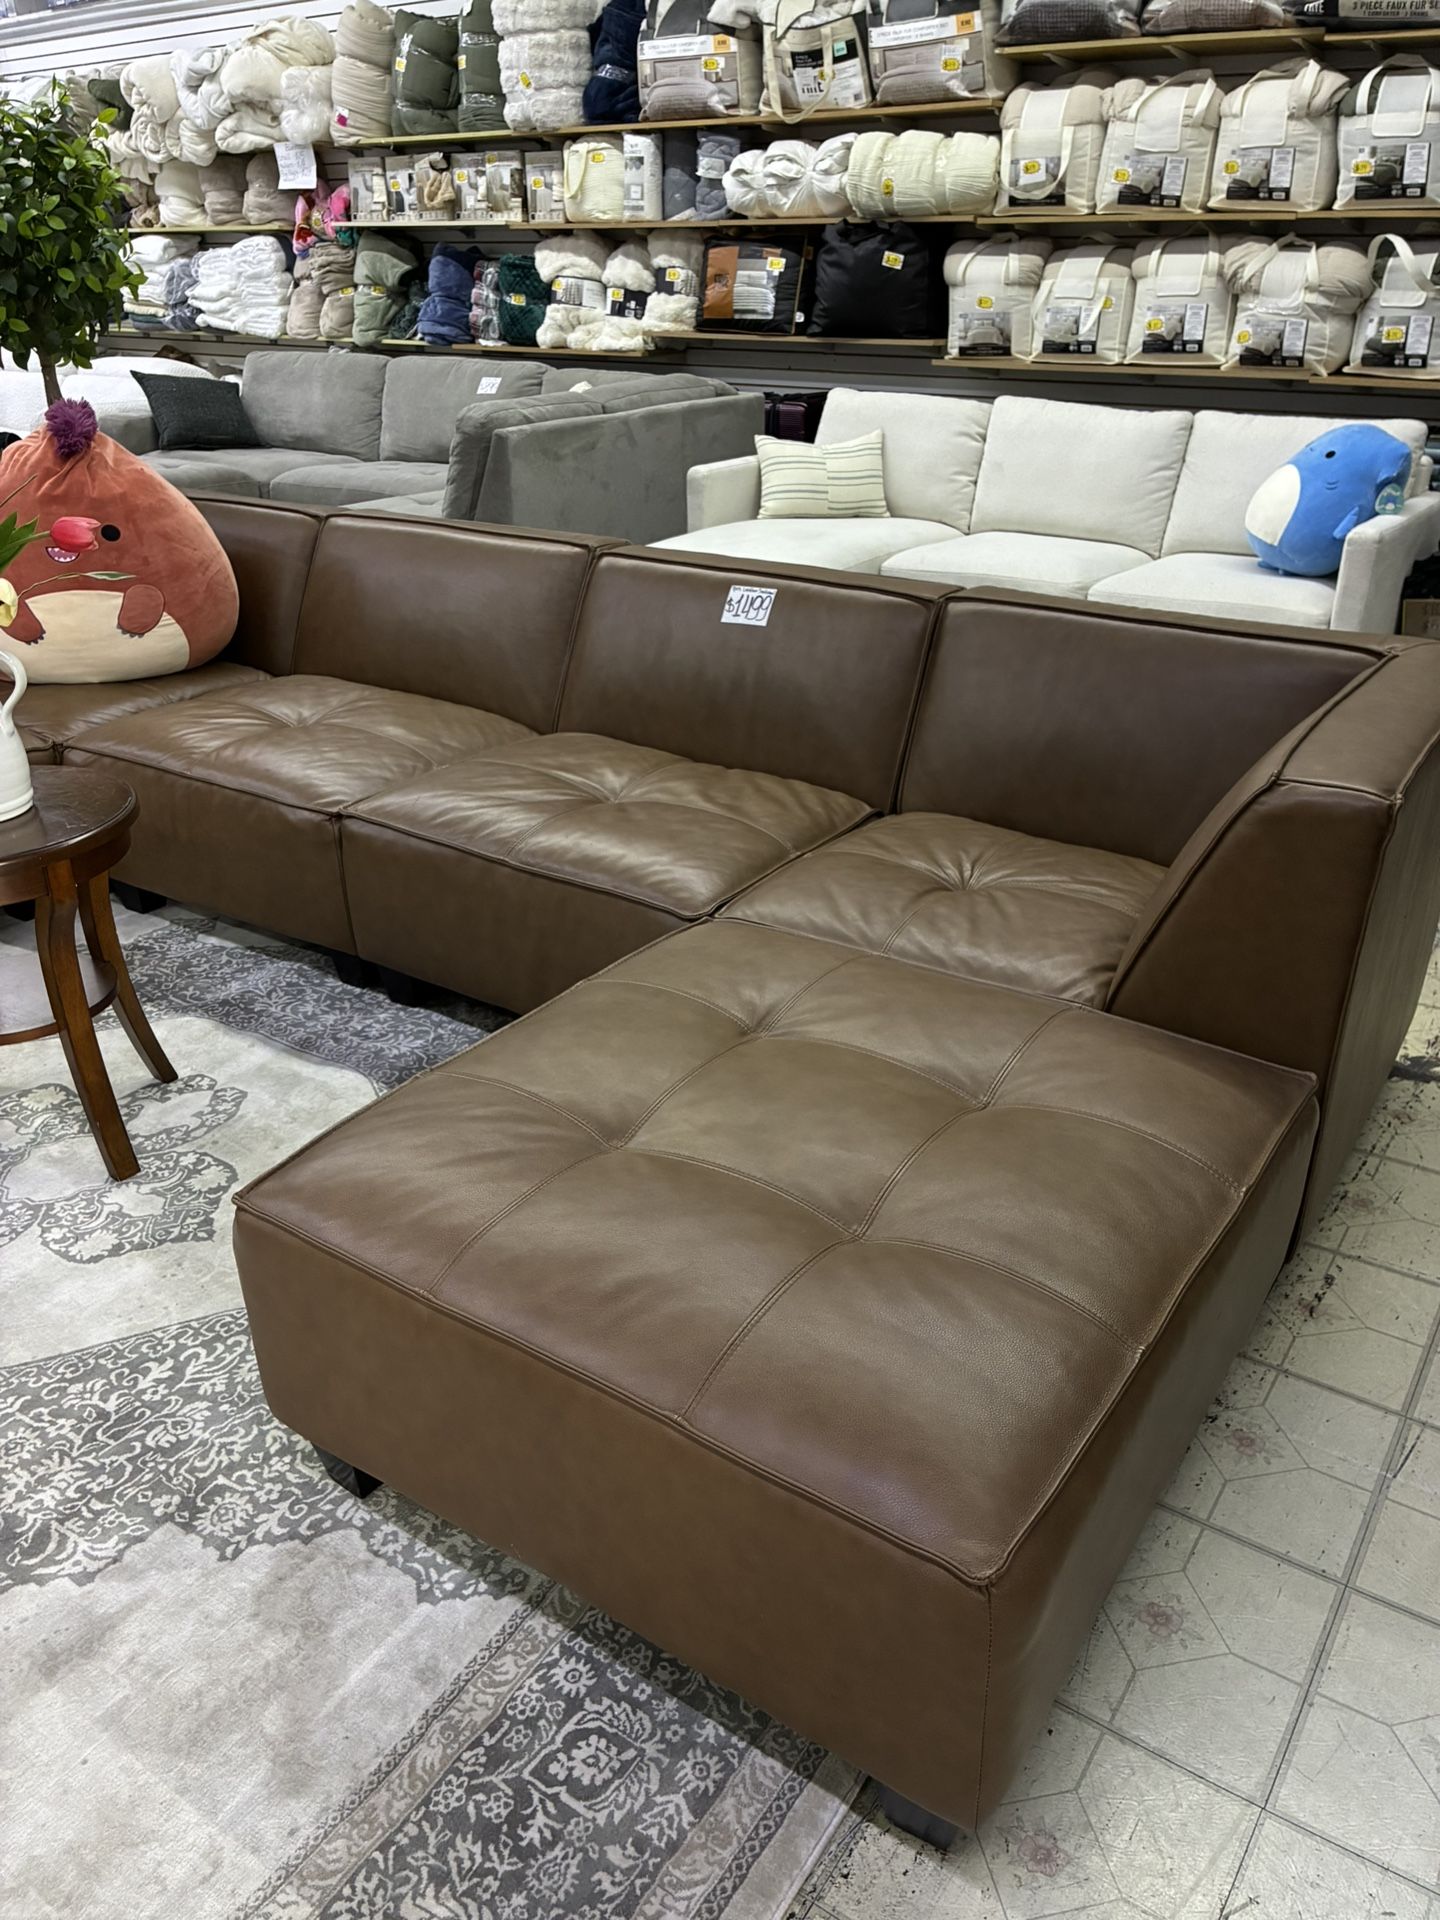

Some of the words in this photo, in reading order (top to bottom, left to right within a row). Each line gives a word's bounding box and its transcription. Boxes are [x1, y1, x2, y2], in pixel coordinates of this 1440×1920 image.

[1360, 0, 1383, 10] PIECE
[1387, 0, 1407, 10] FAUX
[1410, 0, 1427, 9] FUR
[1430, 0, 1440, 9] SE
[725, 594, 773, 622] $1499
